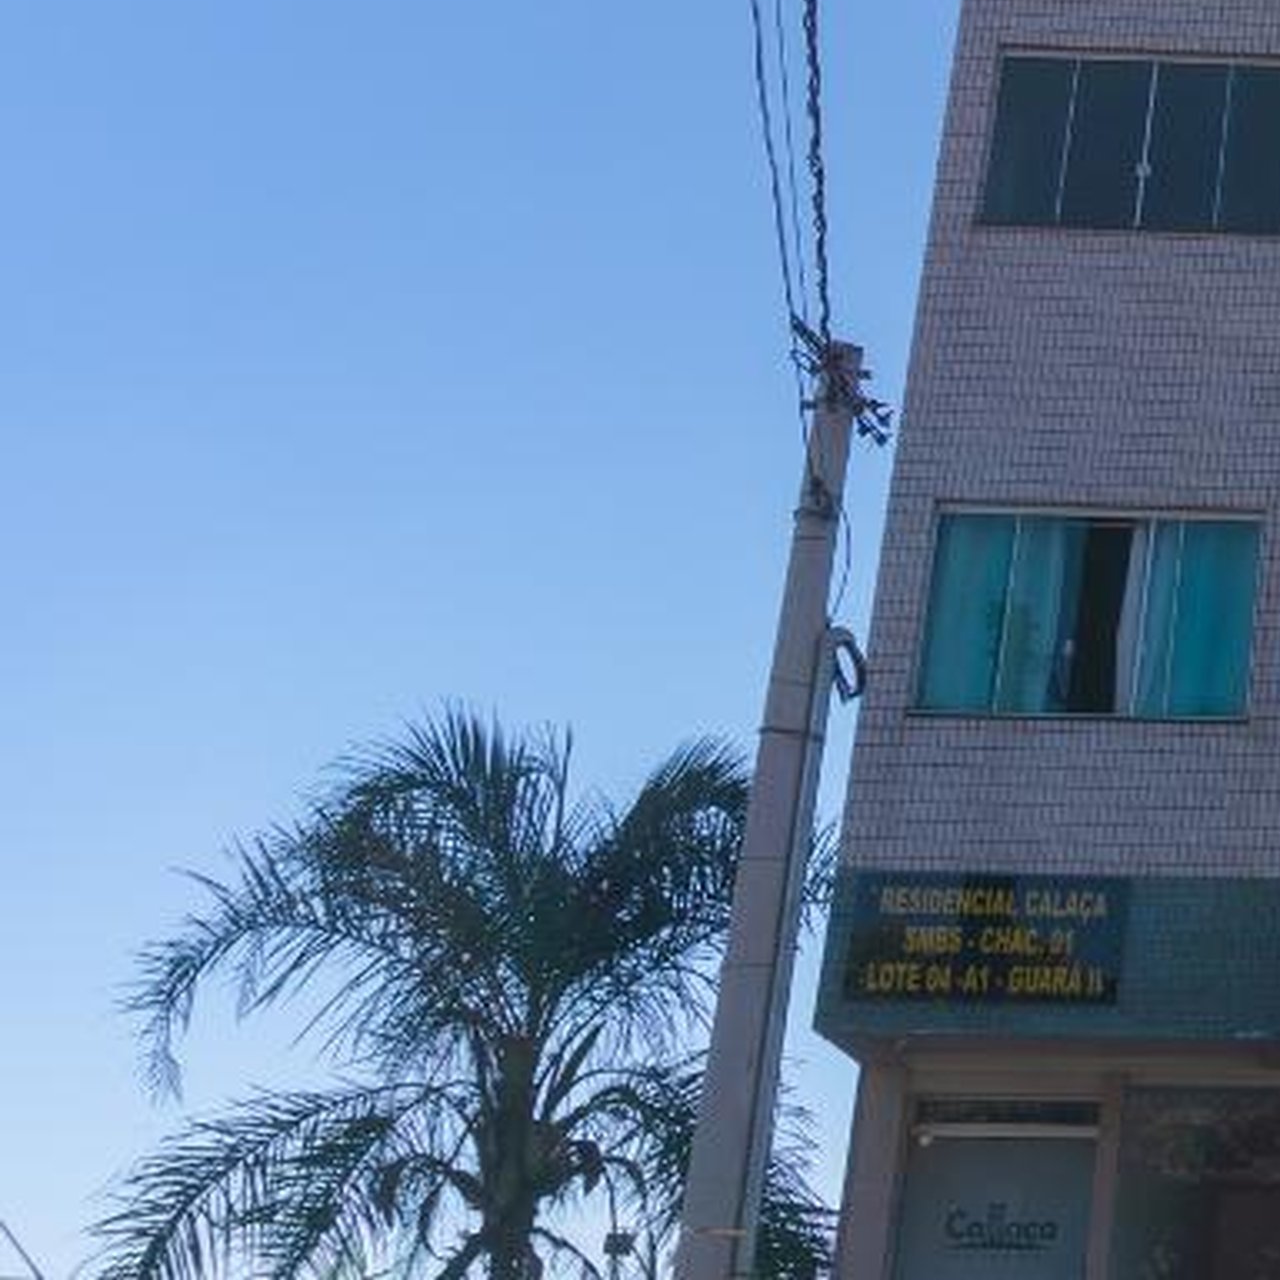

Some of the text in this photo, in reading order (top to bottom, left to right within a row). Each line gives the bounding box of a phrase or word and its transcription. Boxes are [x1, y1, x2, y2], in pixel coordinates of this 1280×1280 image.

[880, 887, 1107, 923] RESIDENCIAL CALAÇA
[867, 961, 922, 991] LOTE
